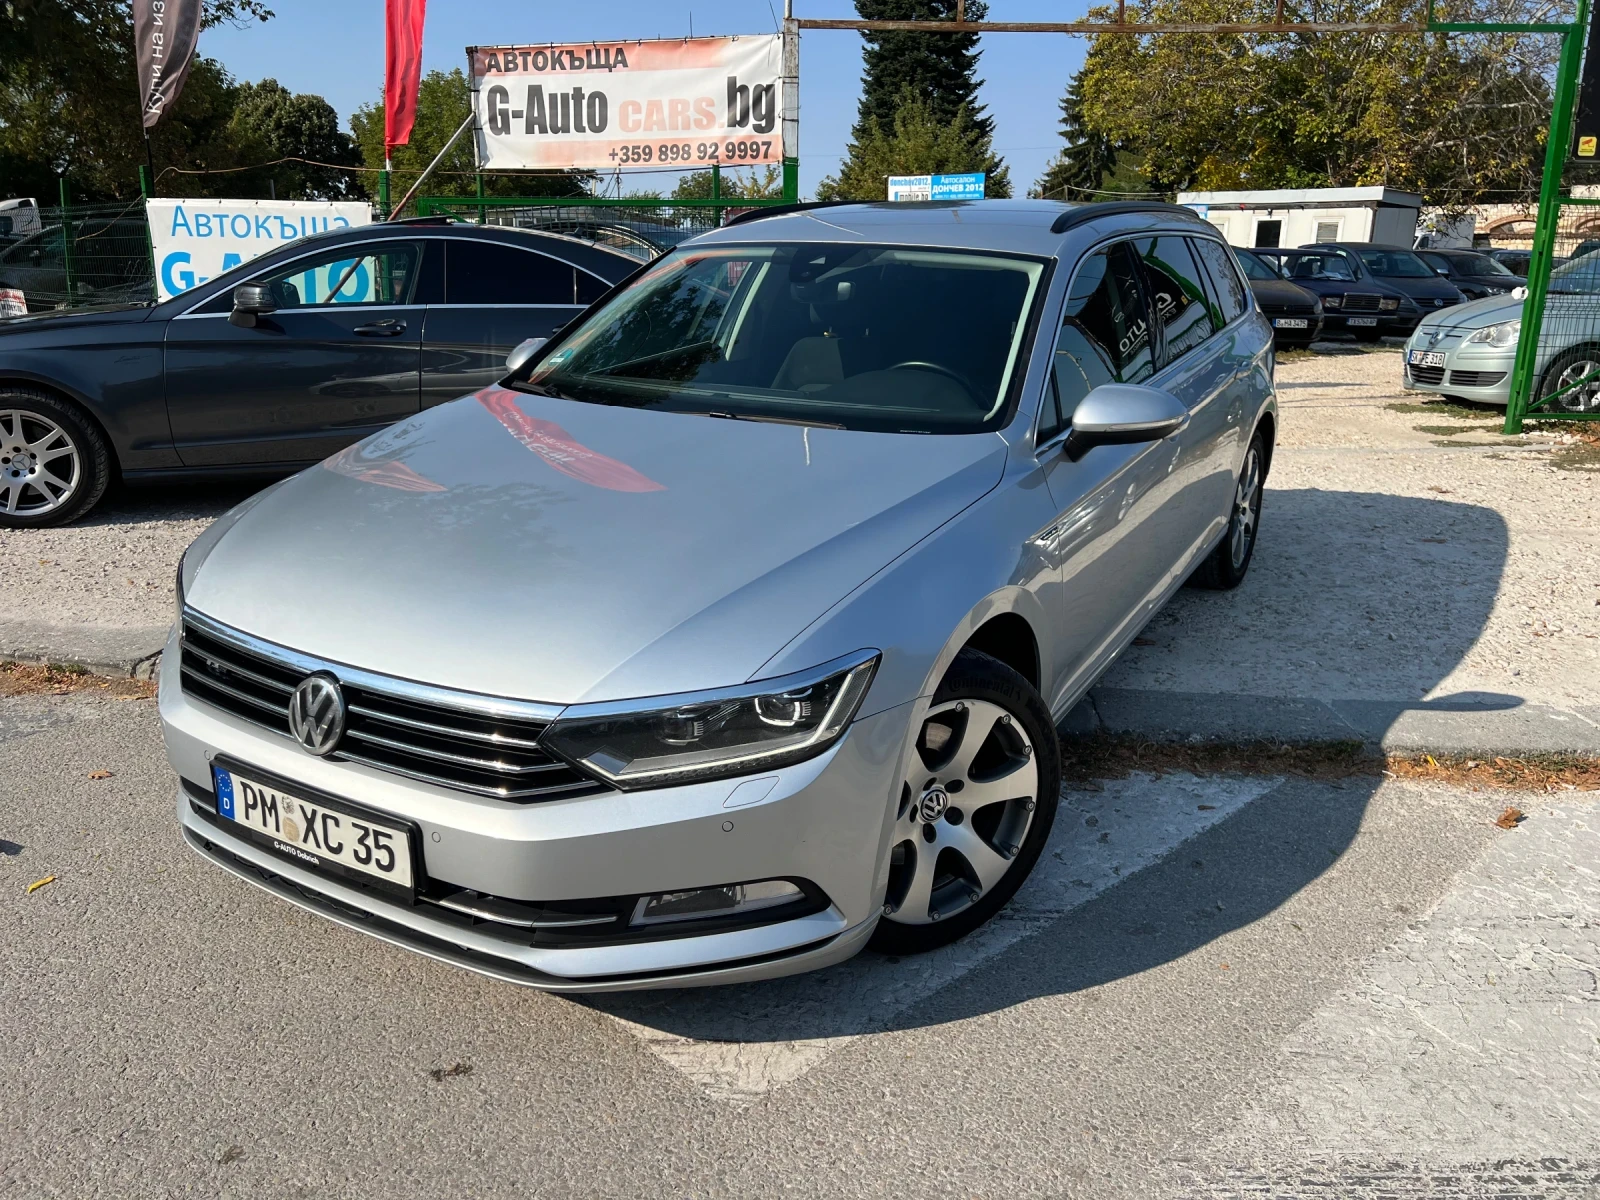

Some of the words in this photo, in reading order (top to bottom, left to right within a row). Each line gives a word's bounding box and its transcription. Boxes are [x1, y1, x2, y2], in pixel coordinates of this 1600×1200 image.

[152, 32, 164, 58] на
[487, 47, 629, 73] АВТОКЪЩА
[146, 66, 165, 113] Купи
[487, 84, 608, 136] G-Auto
[608, 144, 653, 163] +359
[657, 143, 692, 162] 898
[697, 142, 719, 161] 92
[725, 140, 773, 160] 9997
[932, 184, 963, 194] ДОНЧЕВ
[964, 183, 984, 192] 2012
[161, 251, 369, 305] G-TO
[223, 797, 230, 810] D
[240, 780, 281, 833] PM
[299, 804, 344, 855] XC
[352, 821, 395, 873] 35
[273, 840, 297, 857] G-AUTO
[296, 849, 320, 866] Dobrich
